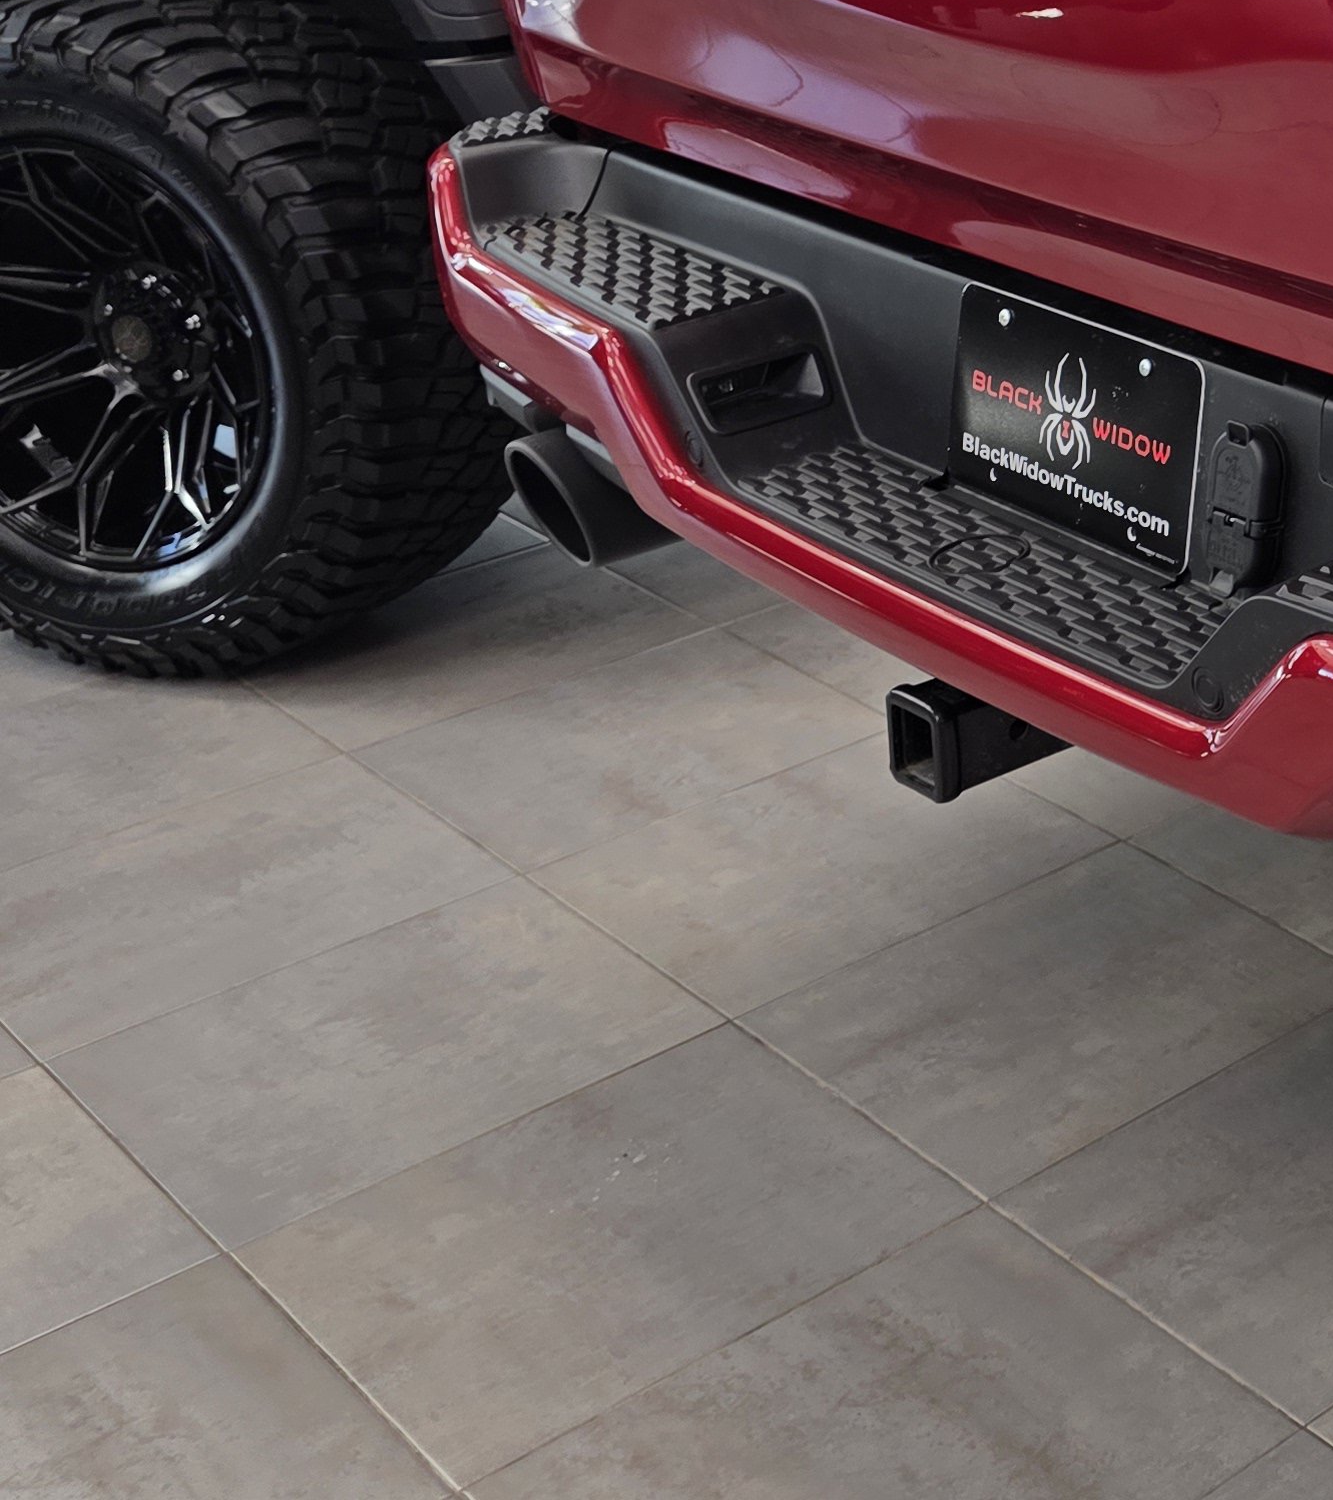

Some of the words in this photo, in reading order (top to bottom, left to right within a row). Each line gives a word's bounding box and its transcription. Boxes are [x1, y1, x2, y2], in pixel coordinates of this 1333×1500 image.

[971, 368, 1043, 416] BLACK
[1091, 416, 1172, 465] WIDOW
[962, 431, 1170, 537] BlackWidowTrucks.com
